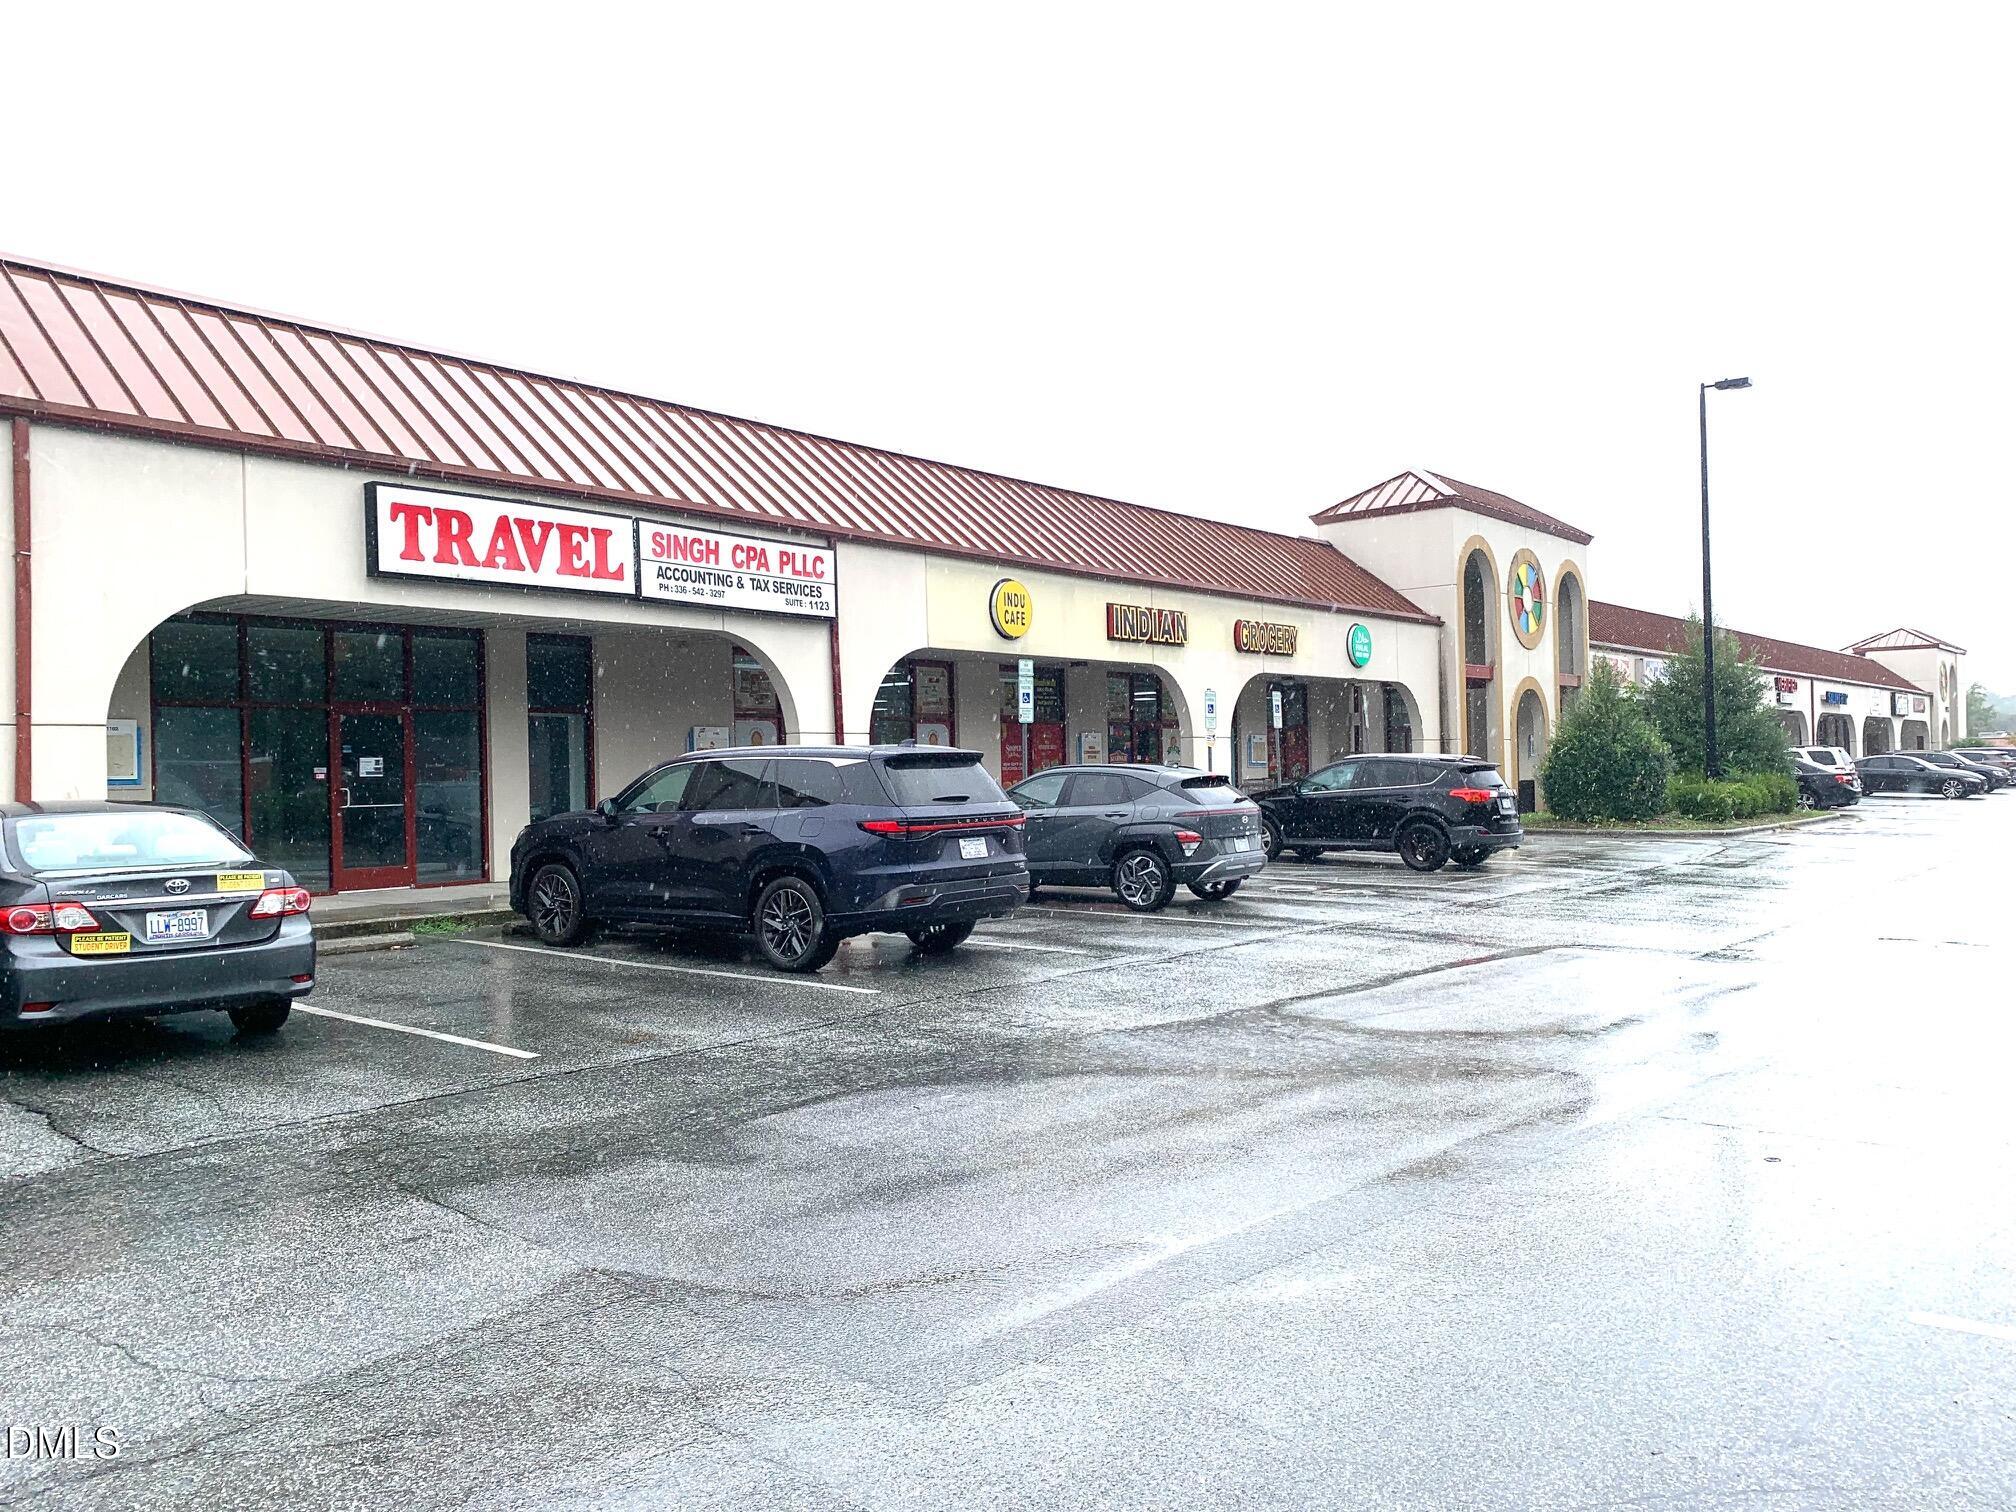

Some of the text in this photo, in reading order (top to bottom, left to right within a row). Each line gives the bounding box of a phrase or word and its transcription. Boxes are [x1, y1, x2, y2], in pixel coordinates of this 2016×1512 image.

[390, 502, 624, 581] TRAVEL
[652, 531, 825, 579] SINGH CPA PLLC
[656, 565, 823, 599] ACCOUNTING & TAX SERVICES
[808, 601, 830, 611] 1123
[1003, 591, 1025, 608] INDU
[1004, 609, 1026, 626] CAFE
[1112, 604, 1189, 644] INDIAN
[1240, 620, 1298, 655] GROCERY
[150, 917, 204, 934] LLW-8997
[74, 942, 127, 951] STUDENT DRIVER
